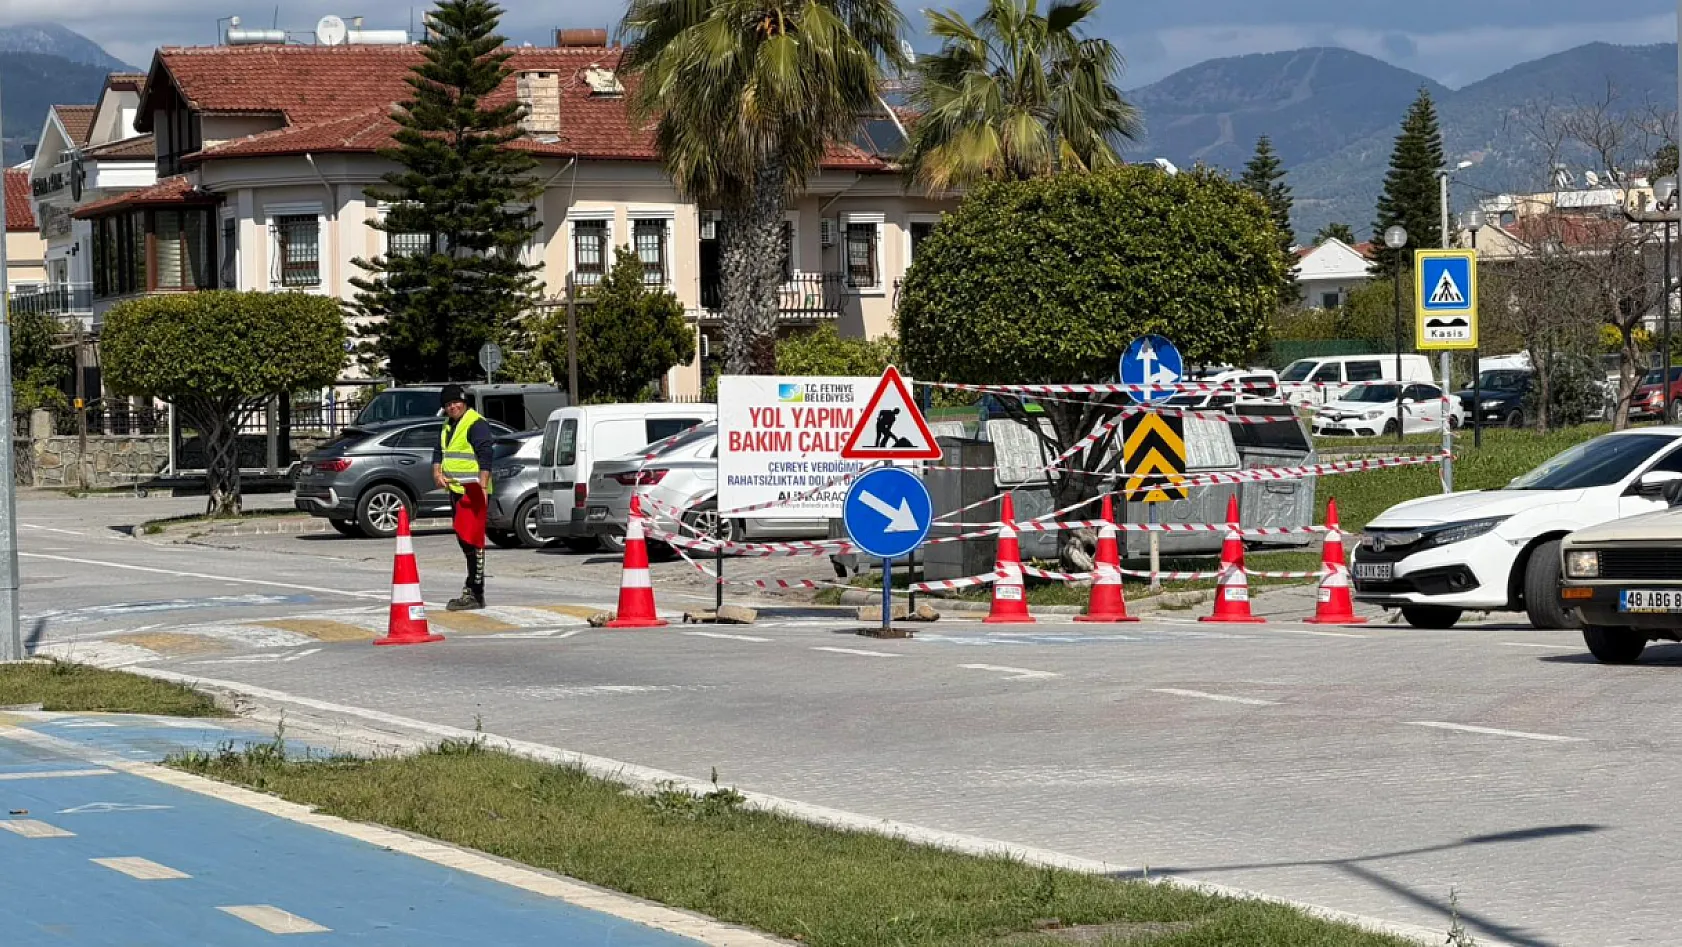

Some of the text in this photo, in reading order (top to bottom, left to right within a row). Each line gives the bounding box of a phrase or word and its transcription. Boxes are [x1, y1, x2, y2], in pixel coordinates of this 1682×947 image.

[1431, 329, 1463, 338] Kasis
[749, 407, 853, 429] YOL YAPIM
[728, 431, 793, 452] BAKIM
[727, 474, 806, 486] RAHATSIZLIKTAN
[1627, 591, 1642, 606] 48
[1647, 592, 1671, 607] ABG
